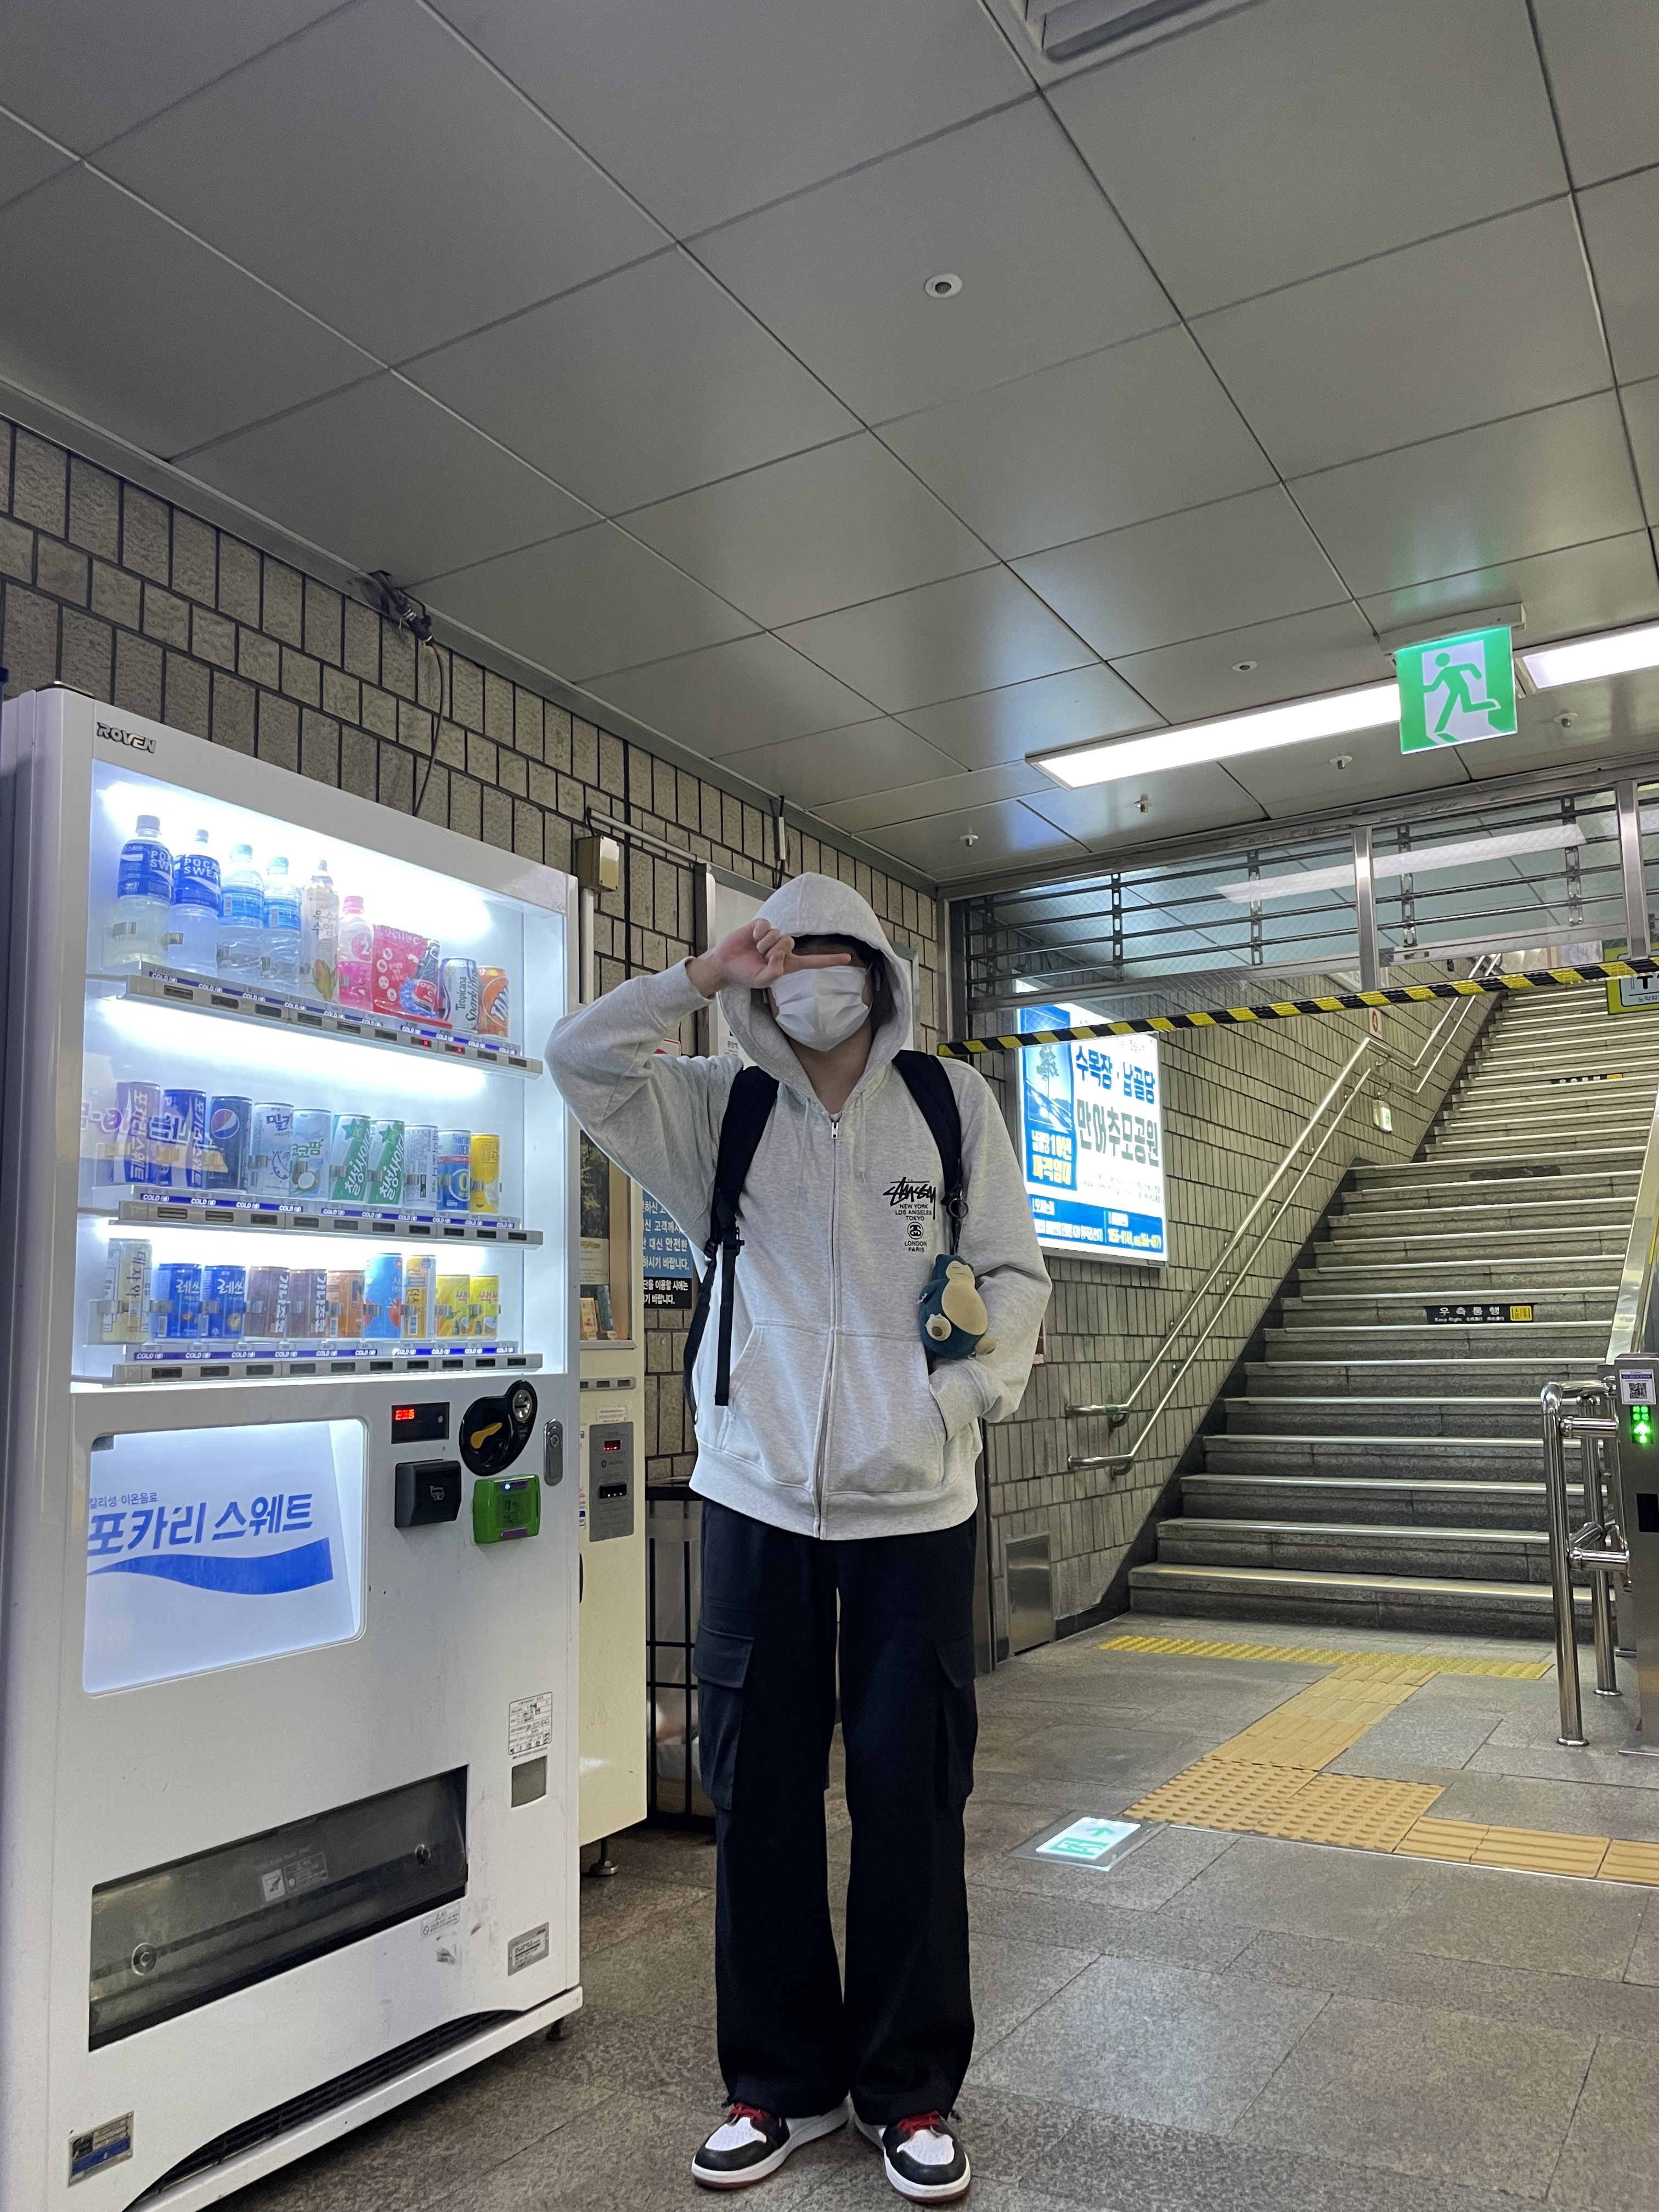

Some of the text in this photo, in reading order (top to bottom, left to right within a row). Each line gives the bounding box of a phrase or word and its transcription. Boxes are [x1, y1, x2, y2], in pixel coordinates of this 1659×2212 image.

[152, 973, 168, 981] COLD
[242, 992, 257, 1001] COLD
[455, 977, 467, 1011] Tropicana
[1076, 1046, 1155, 1105] 수목장 납골당
[643, 1200, 658, 1214] 하신
[649, 1238, 663, 1250] 대신
[665, 1237, 688, 1252] 안전한
[662, 1257, 690, 1271] 바랍니다.
[126, 1251, 146, 1298] 데자와
[655, 1279, 672, 1291] 이용할
[673, 1280, 689, 1291] 시에는
[651, 1294, 675, 1305] 바랍니다.
[121, 1492, 158, 1505] 이온음료
